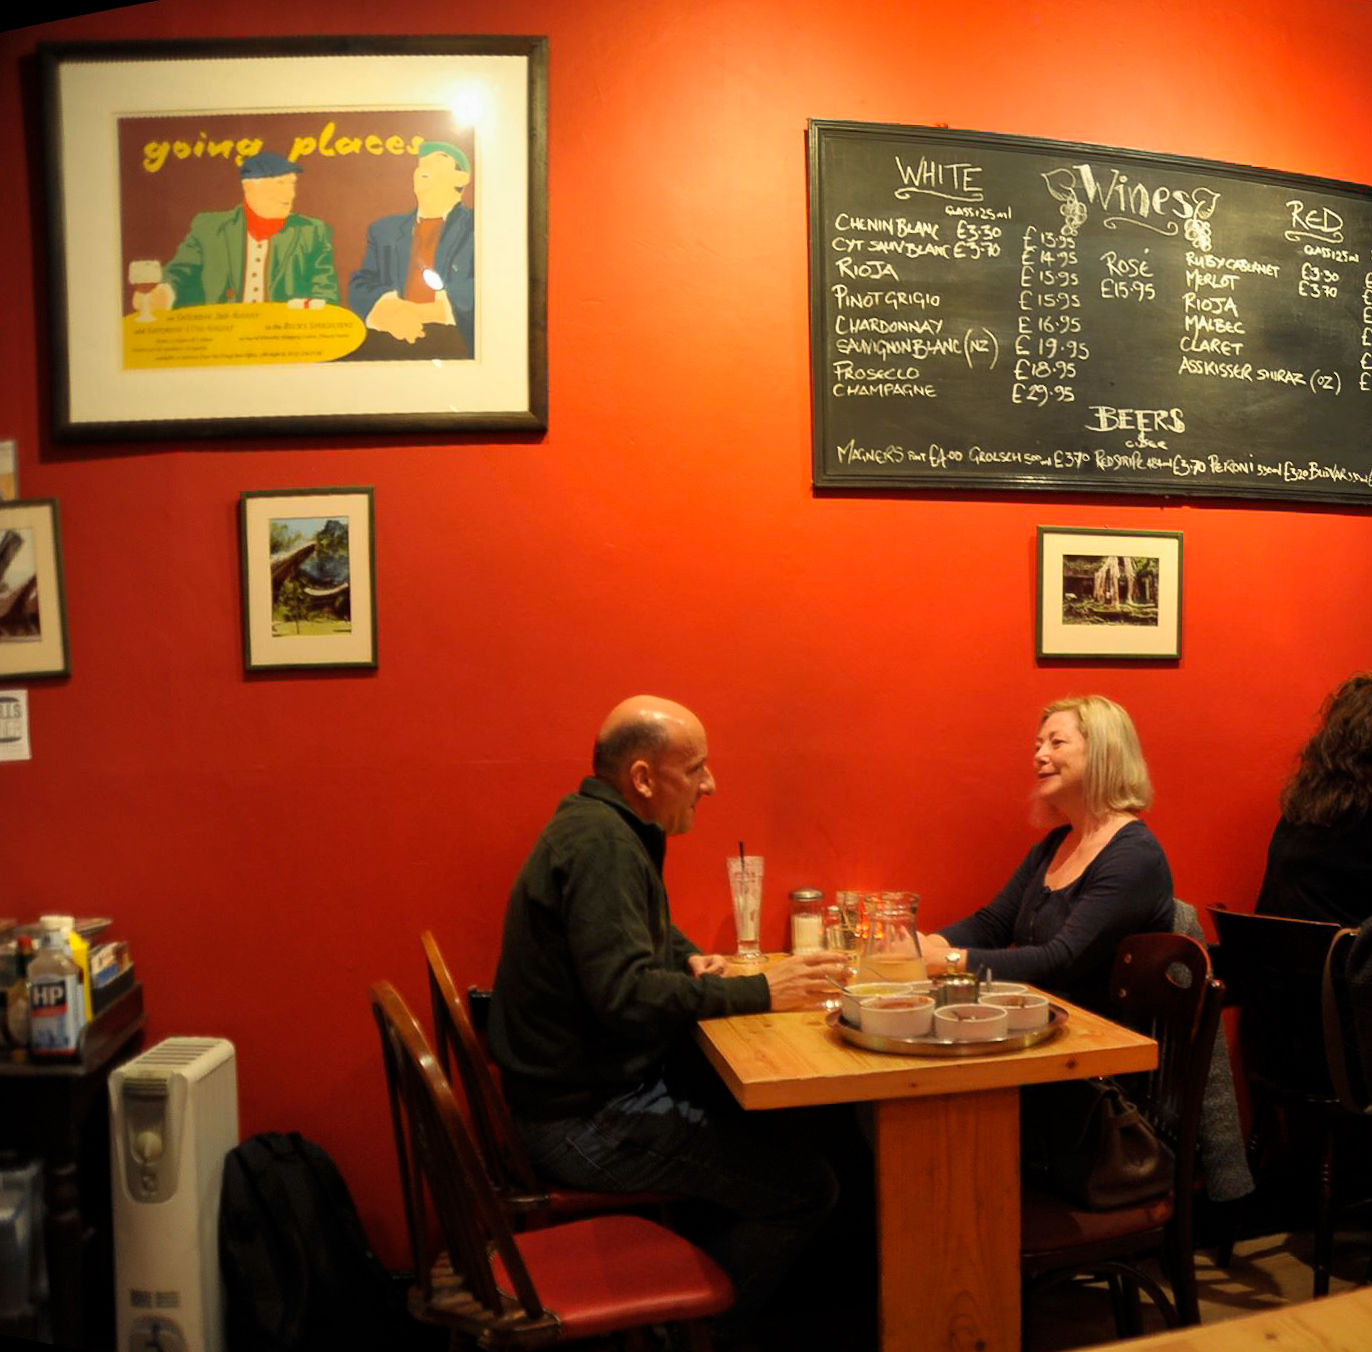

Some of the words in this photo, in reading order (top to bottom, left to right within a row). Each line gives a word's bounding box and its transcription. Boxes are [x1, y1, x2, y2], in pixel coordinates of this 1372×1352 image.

[143, 131, 263, 172] going
[288, 122, 424, 163] places
[895, 156, 983, 192] WHITE
[1072, 164, 1194, 219] Wines
[835, 213, 894, 236] CHENIN
[895, 218, 940, 241] BLANC
[957, 220, 1002, 242] £3.30
[1286, 200, 1343, 233] RED
[905, 243, 951, 260] BLANC
[953, 241, 1001, 259] £3.70
[835, 257, 899, 282] RIOJA
[1185, 251, 1226, 269] RUBY
[1301, 262, 1340, 283] £3.30
[831, 284, 884, 310] PINOT
[884, 291, 941, 311] GRIGIO
[1101, 278, 1156, 302] £15.95
[1185, 269, 1241, 292] MERLOT
[1299, 280, 1338, 299] £3.70
[1182, 292, 1239, 318] RIOJA
[835, 315, 943, 335] CHARDONNAY
[1185, 315, 1246, 341] MALBEC
[912, 338, 962, 360] BLANC
[964, 327, 999, 370] (NZ)
[1180, 336, 1244, 357] CLARET
[833, 361, 920, 382] PROSECCO
[1013, 358, 1077, 380] £18.95
[1178, 355, 1252, 382] ASSKISSER
[1310, 369, 1341, 396] (OZ)
[832, 384, 937, 398] CHAMPAGNE
[1012, 383, 1075, 408] £29.95
[1084, 405, 1186, 434] BEERS
[837, 439, 904, 464] MAGNERS
[968, 446, 1022, 465] GROLSCH
[1094, 449, 1114, 471] RED
[1173, 454, 1206, 476] £3.70
[1208, 454, 1254, 475] PERONI
[33, 985, 64, 1006] HP
